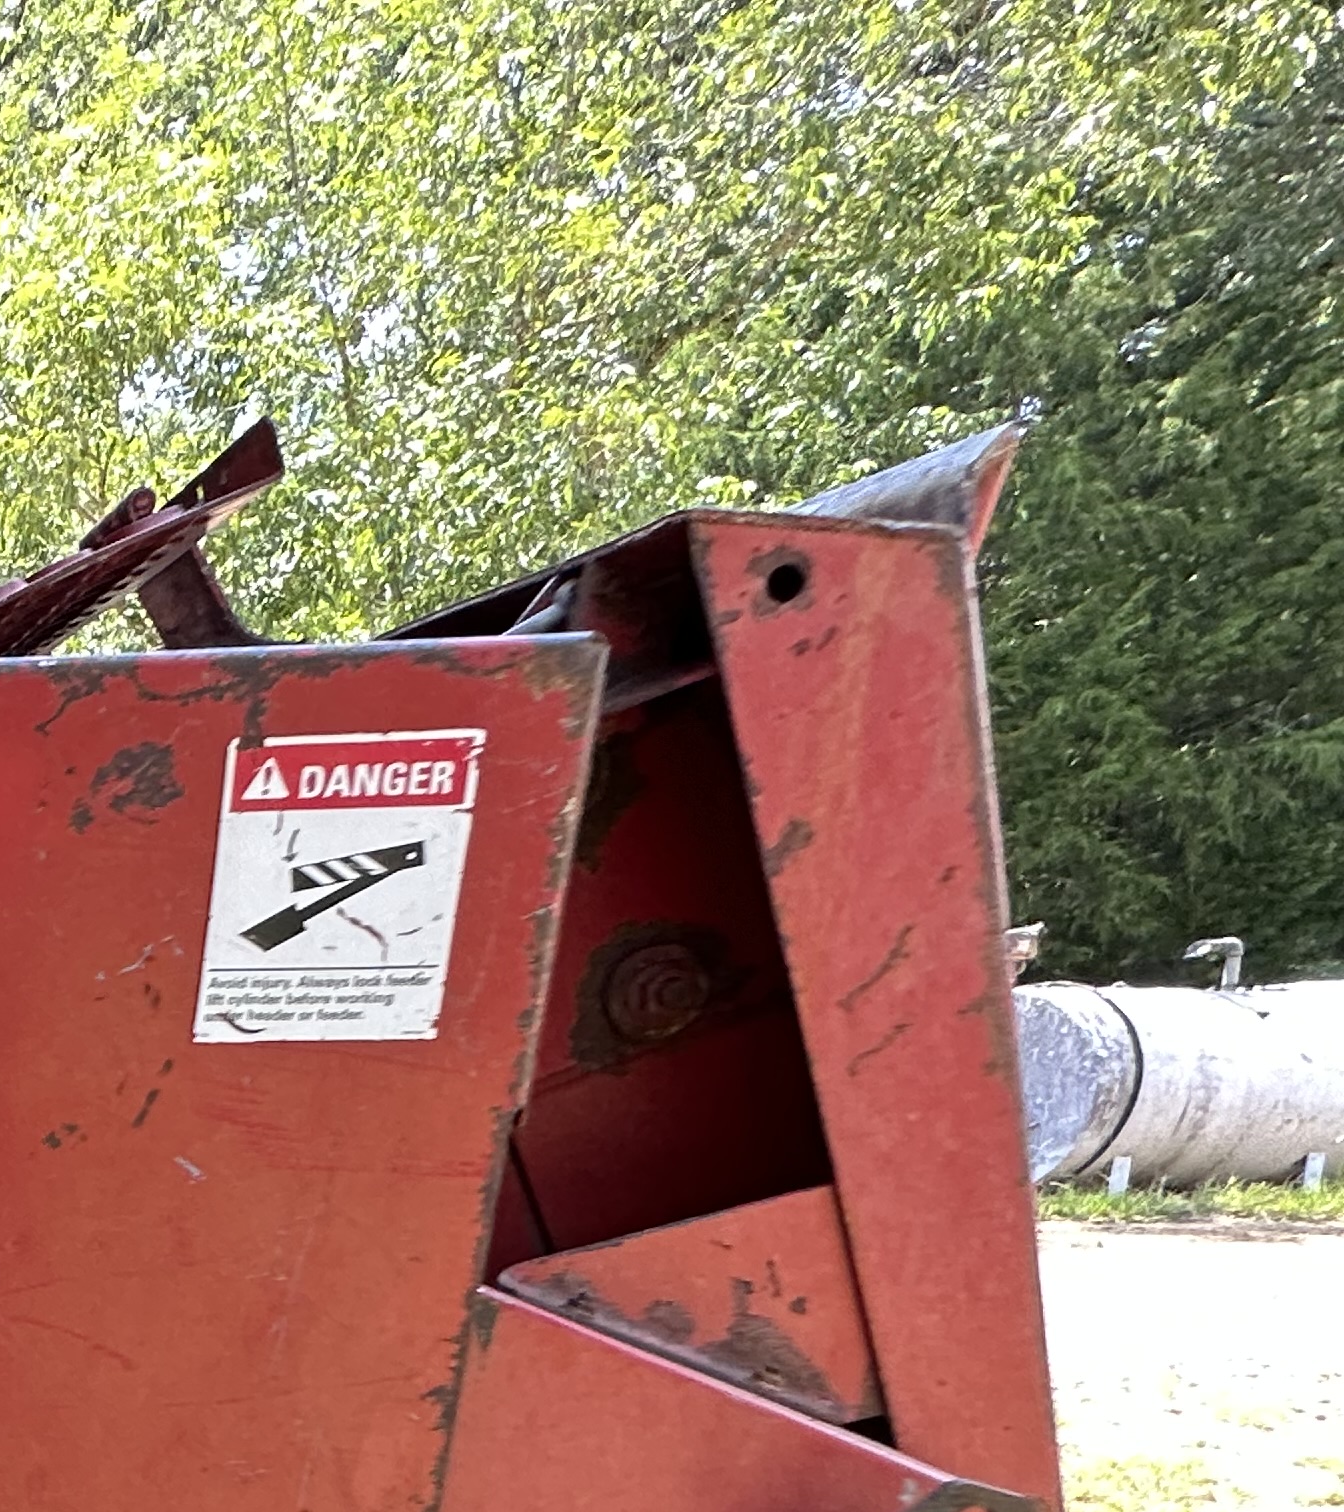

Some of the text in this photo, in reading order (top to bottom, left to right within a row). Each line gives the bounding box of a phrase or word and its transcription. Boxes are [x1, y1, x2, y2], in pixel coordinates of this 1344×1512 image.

[297, 760, 456, 799] DANGER
[208, 976, 248, 989] Avoid
[296, 976, 350, 990] Always
[352, 975, 382, 987] lock
[385, 973, 432, 987] feeder
[227, 993, 283, 1007] cylinder
[285, 993, 331, 1005] before
[334, 992, 395, 1007] working
[246, 1009, 296, 1021] header
[297, 1012, 314, 1021] or
